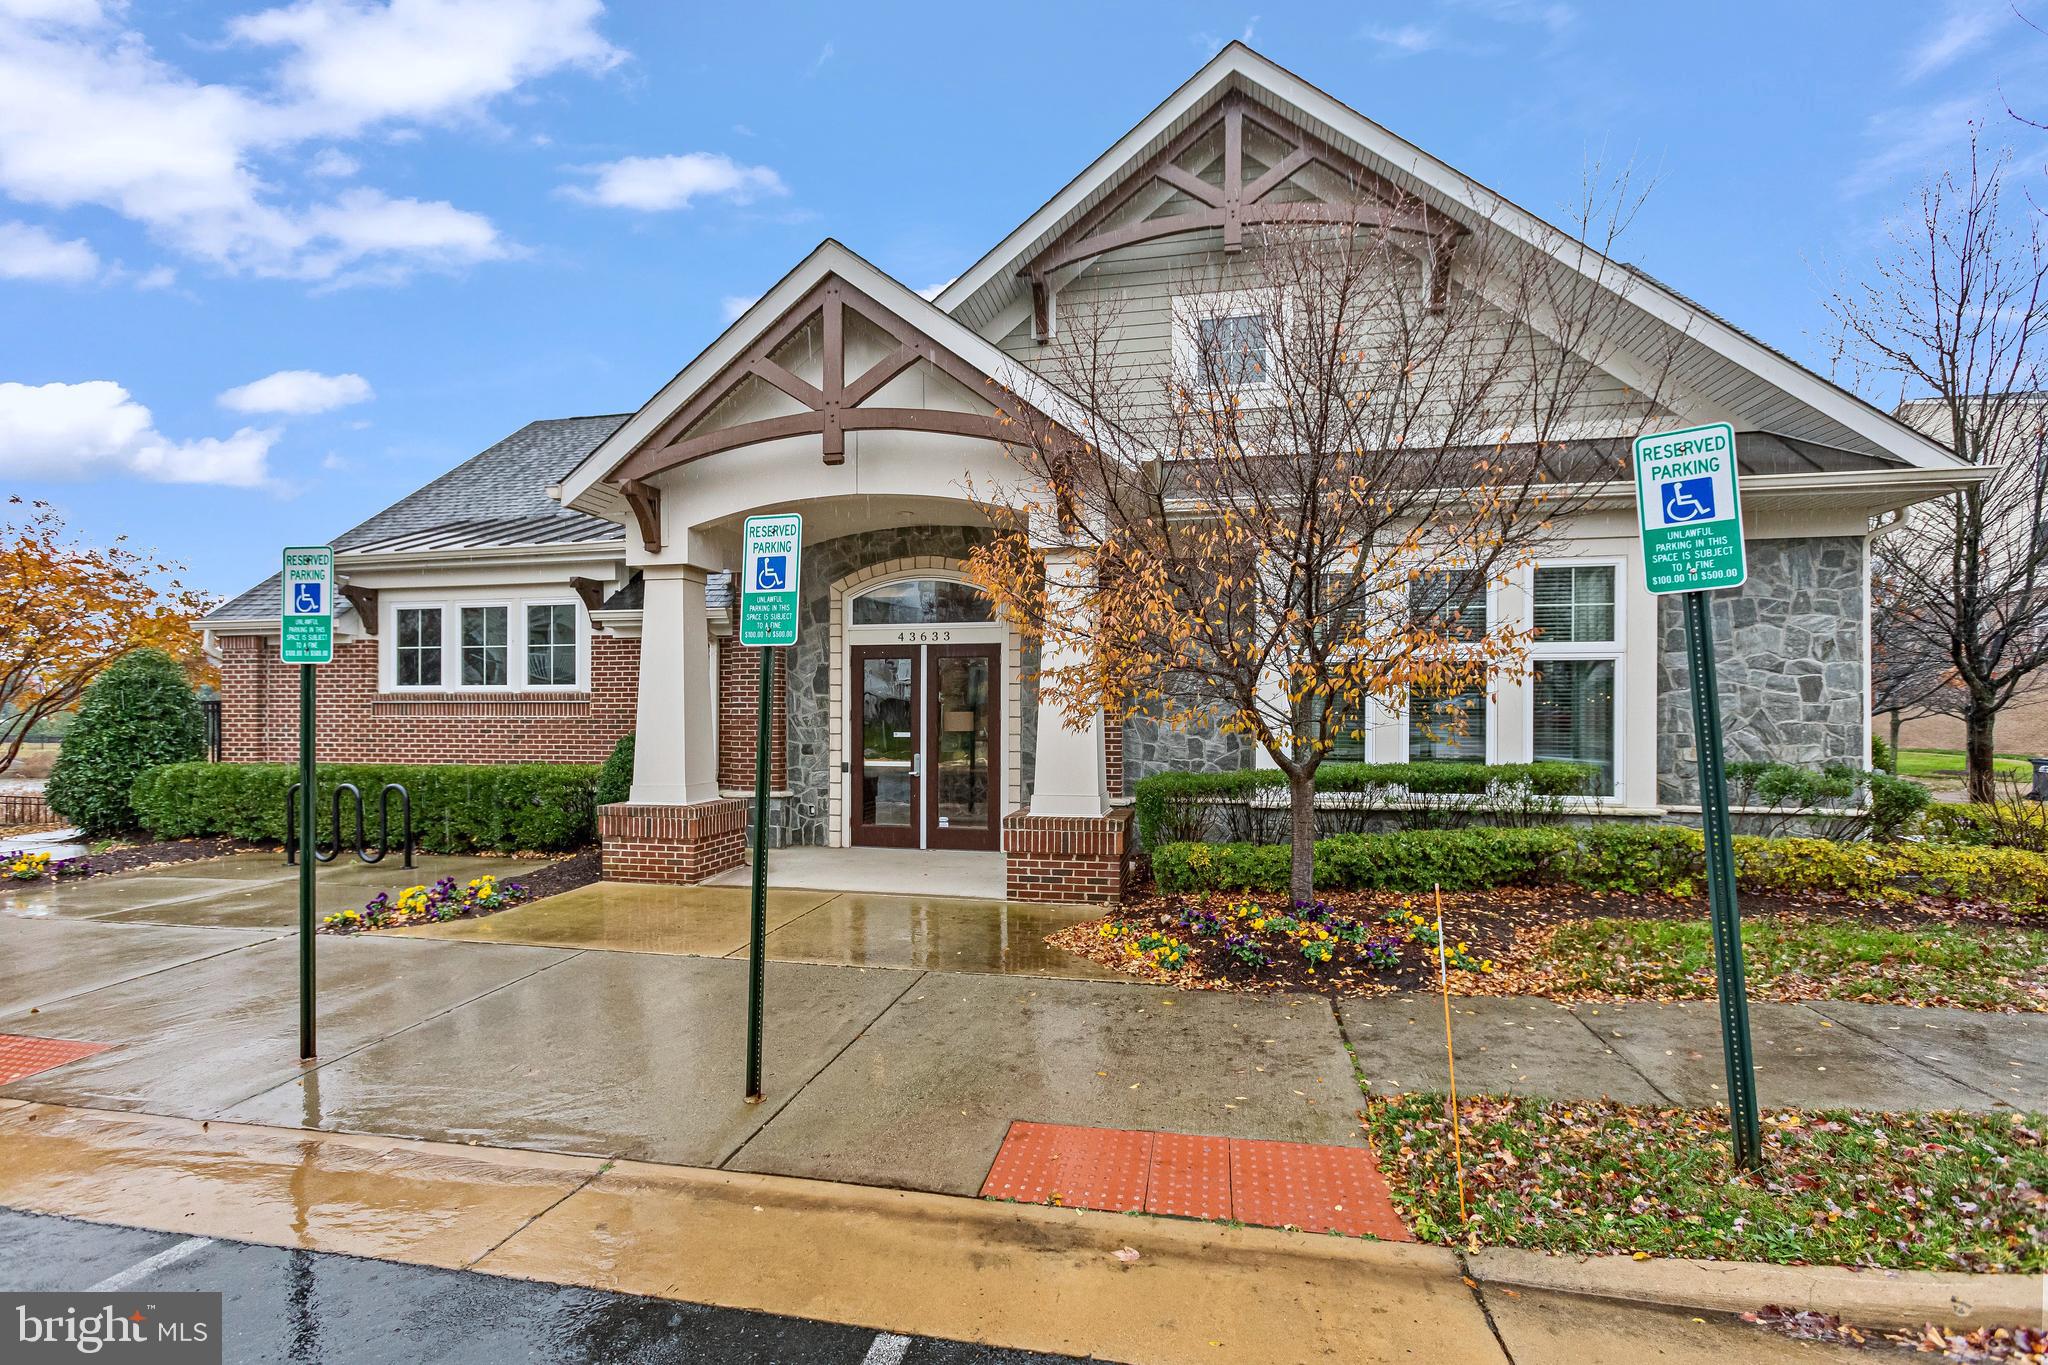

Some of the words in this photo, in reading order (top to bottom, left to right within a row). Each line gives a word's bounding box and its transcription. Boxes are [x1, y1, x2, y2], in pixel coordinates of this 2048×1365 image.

[1643, 435, 1726, 462] RESERVED
[1651, 457, 1720, 481] PARKING
[749, 524, 797, 538] RESERVED
[1667, 527, 1714, 540] UNLAWFUL
[753, 540, 792, 554] PARKING
[1655, 539, 1692, 552] PARKING
[1695, 537, 1704, 547] IN
[1708, 535, 1728, 546] THIS
[287, 554, 329, 566] RESERVED
[1652, 552, 1678, 564] SPACE
[1682, 550, 1691, 560] IS
[1694, 546, 1734, 559] SUBJECT
[1672, 562, 1683, 572] TO
[1686, 561, 1692, 570] A
[1695, 559, 1715, 570] FINE
[290, 570, 326, 580] PARKING
[1652, 572, 1685, 586] $100.00
[1688, 571, 1697, 582] TO
[1701, 568, 1738, 581] $500.00
[756, 595, 783, 603] UNLAWFUL
[749, 604, 770, 612] PARKING
[770, 612, 792, 620] SUBJECT
[898, 631, 951, 642] 43633
